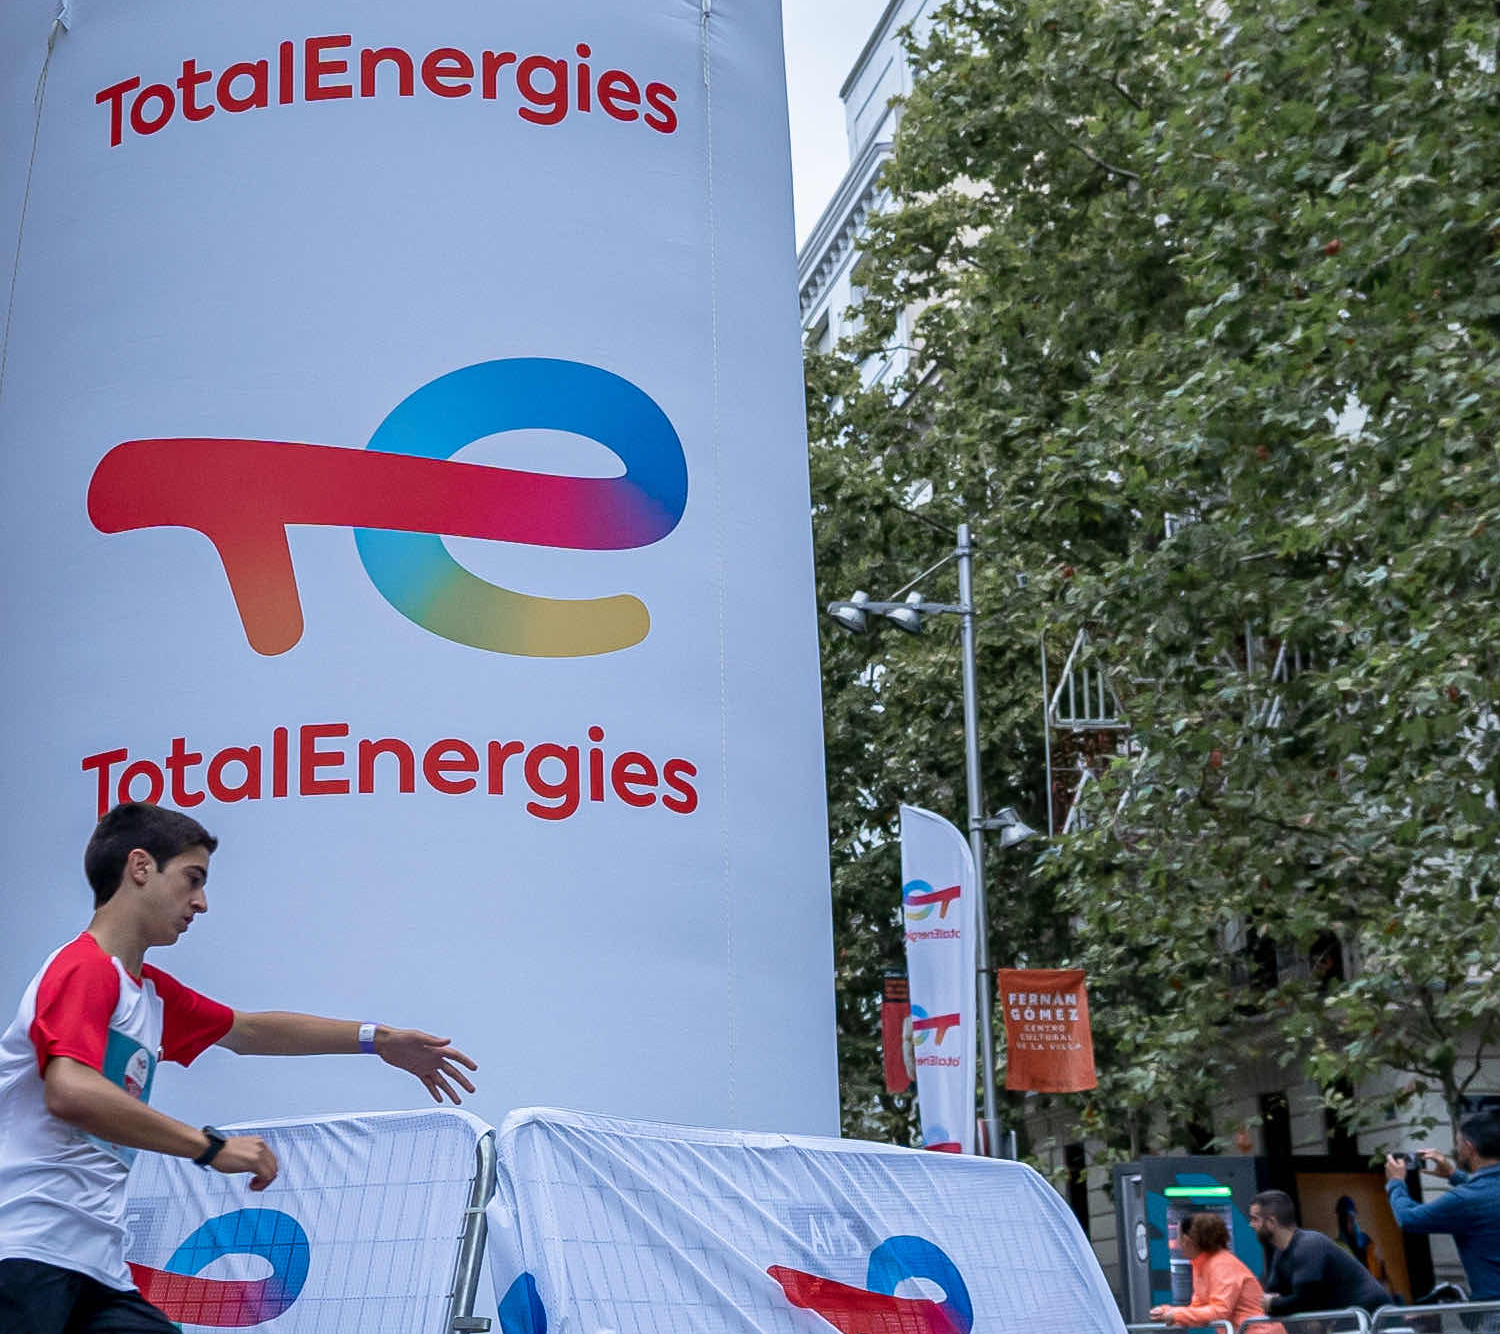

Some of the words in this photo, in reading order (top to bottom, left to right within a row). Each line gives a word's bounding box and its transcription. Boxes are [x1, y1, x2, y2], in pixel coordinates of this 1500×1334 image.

[94, 34, 678, 148] TotalEnergies
[81, 721, 698, 822] TotalEnergies
[1008, 991, 1077, 1005] FERNÁN
[1011, 1007, 1080, 1021] GÓMEZ
